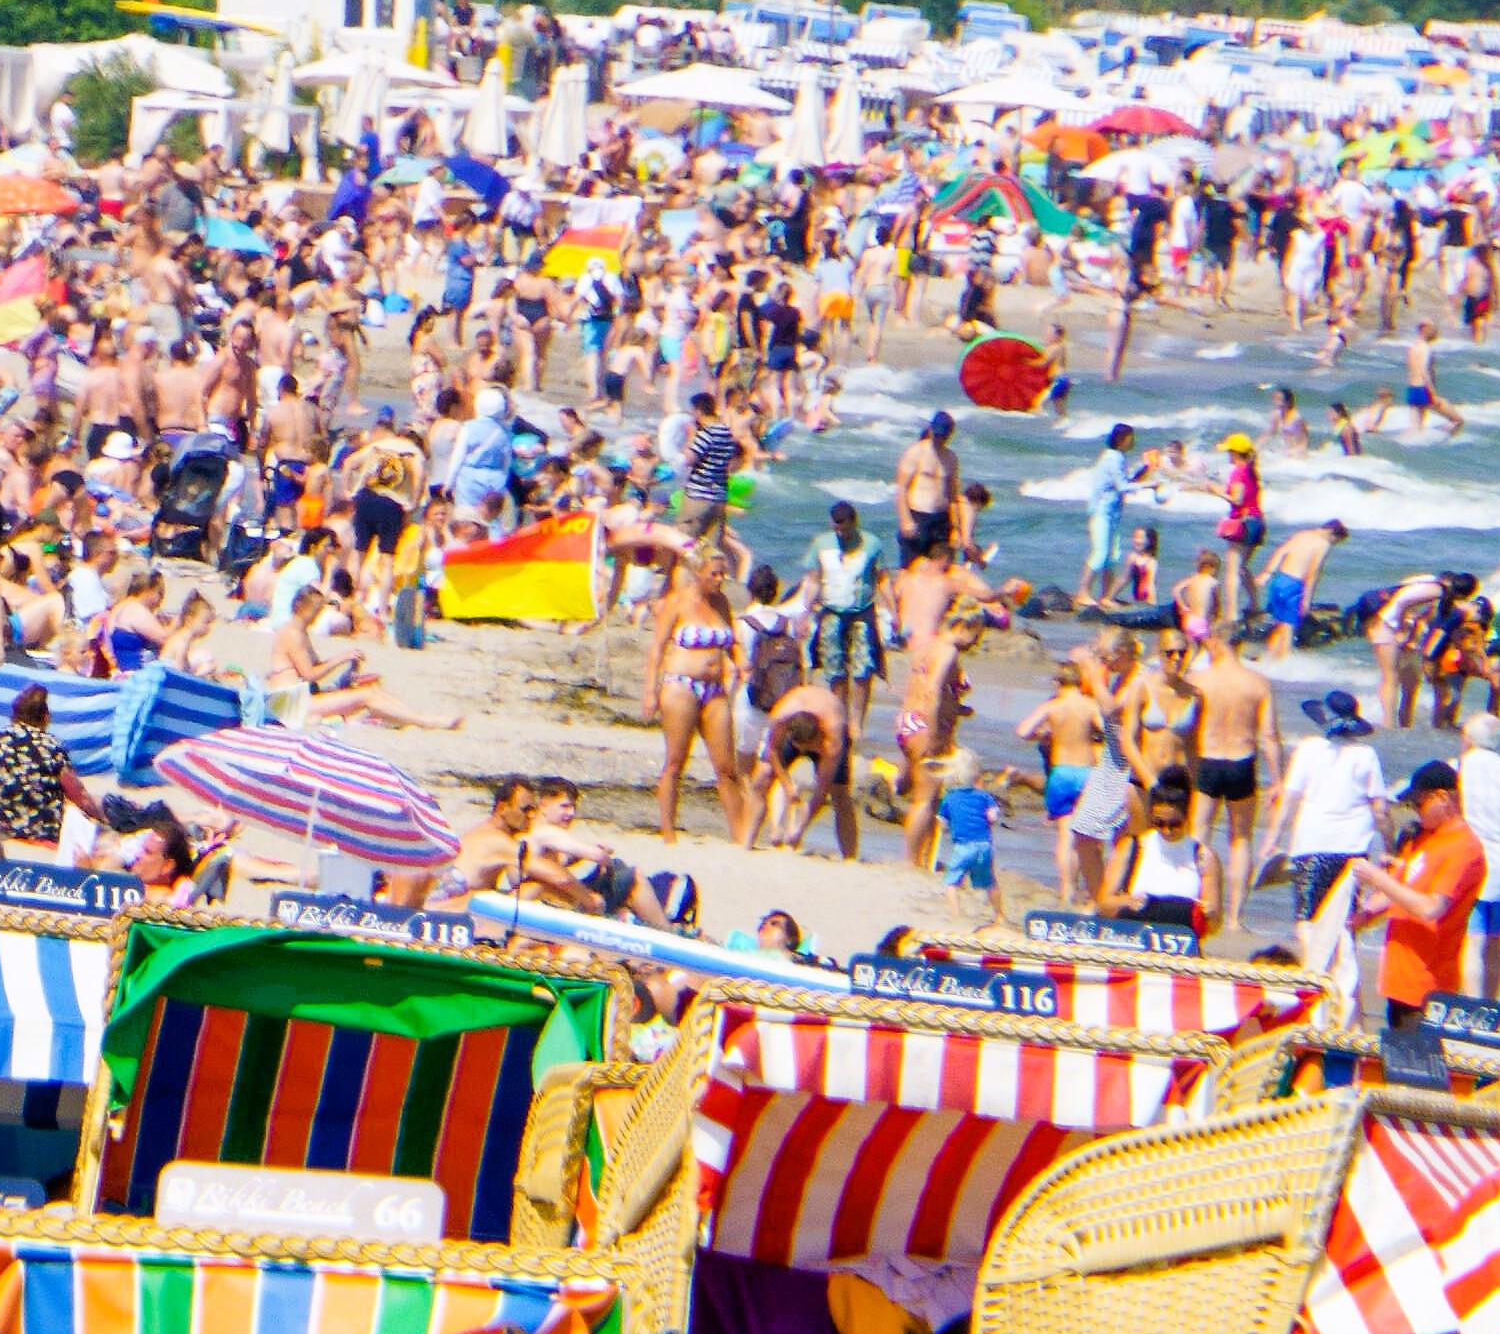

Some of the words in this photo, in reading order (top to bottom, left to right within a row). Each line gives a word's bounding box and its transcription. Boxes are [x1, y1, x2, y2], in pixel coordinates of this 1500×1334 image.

[35, 874, 99, 900] Beach
[421, 920, 469, 944] 118
[1149, 932, 1193, 955] 157
[877, 966, 936, 994] Rikki
[940, 972, 1008, 999] Beach
[1001, 985, 1053, 1012] 116
[193, 1177, 277, 1217] Rikki
[281, 1180, 375, 1216] Beach
[372, 1195, 423, 1231] 66
